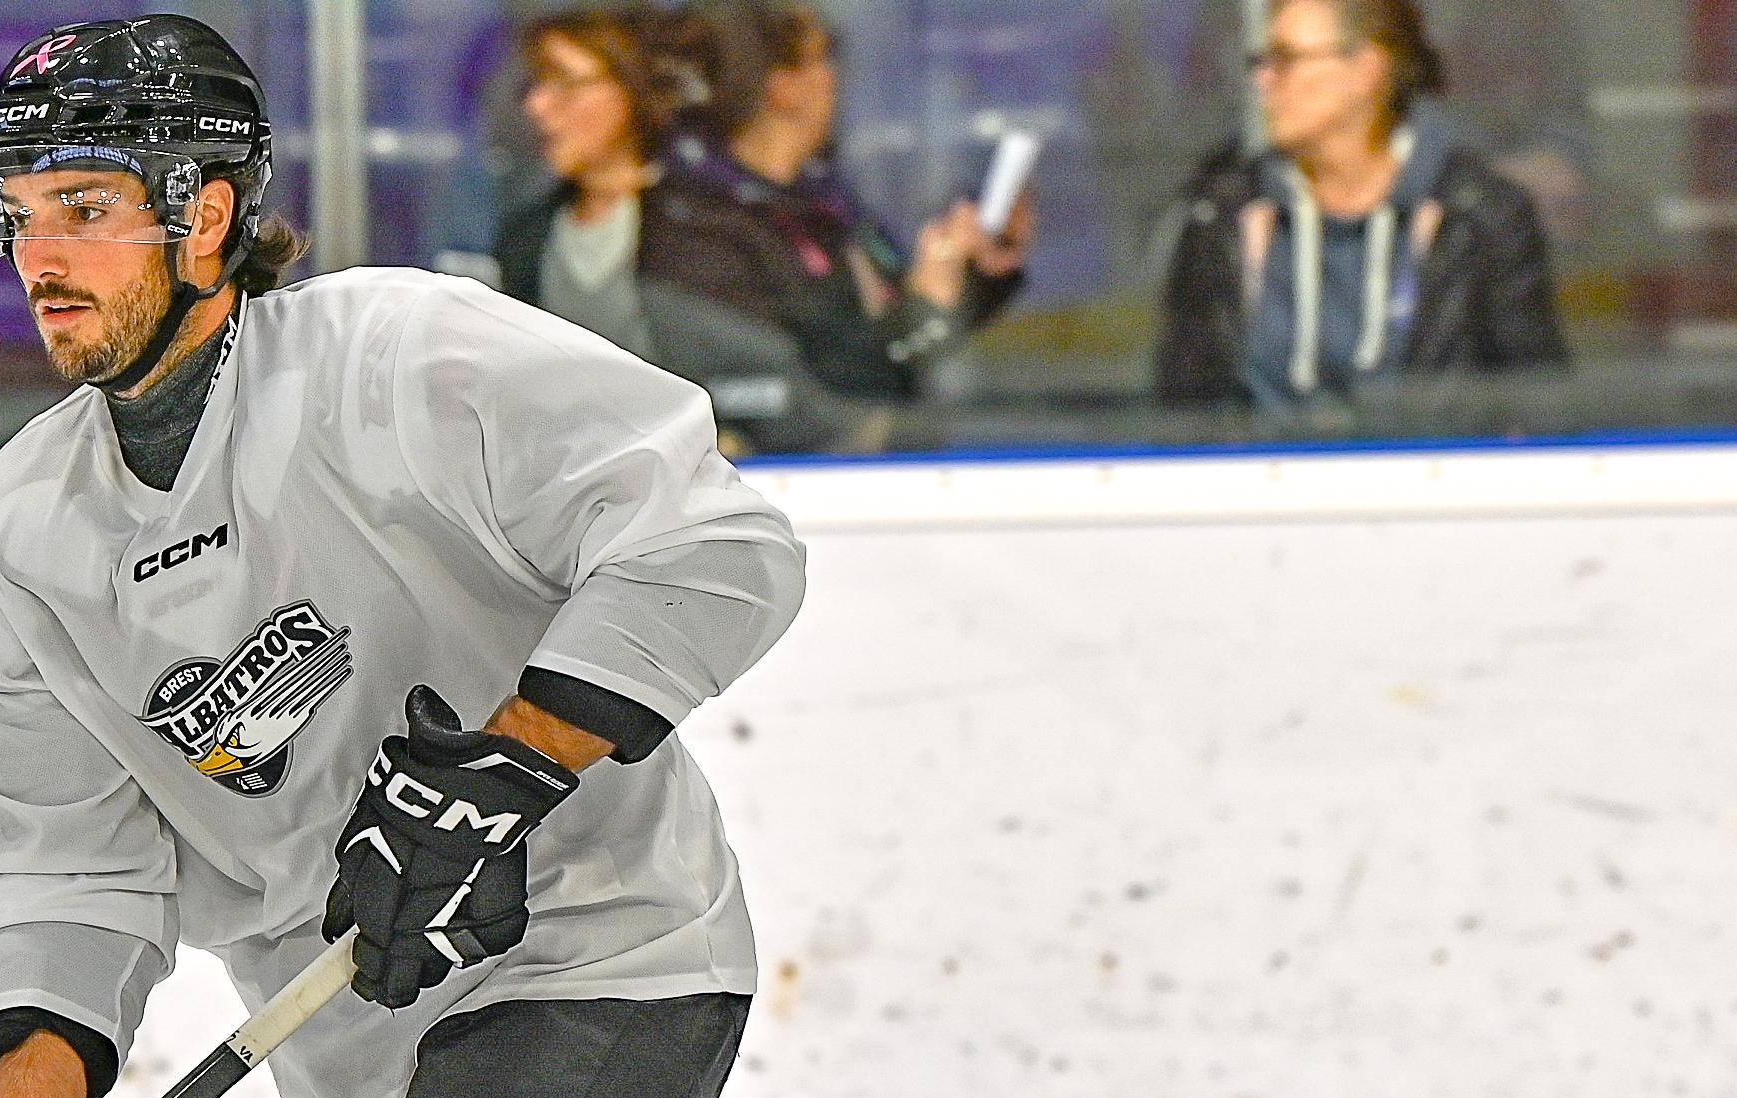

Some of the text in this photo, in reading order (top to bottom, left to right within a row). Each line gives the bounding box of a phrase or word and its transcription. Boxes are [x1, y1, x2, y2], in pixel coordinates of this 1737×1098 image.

[198, 116, 251, 135] CCM
[167, 224, 190, 236] CCM
[132, 522, 229, 583] CCM
[158, 666, 203, 703] BREST
[367, 750, 522, 844] CCM
